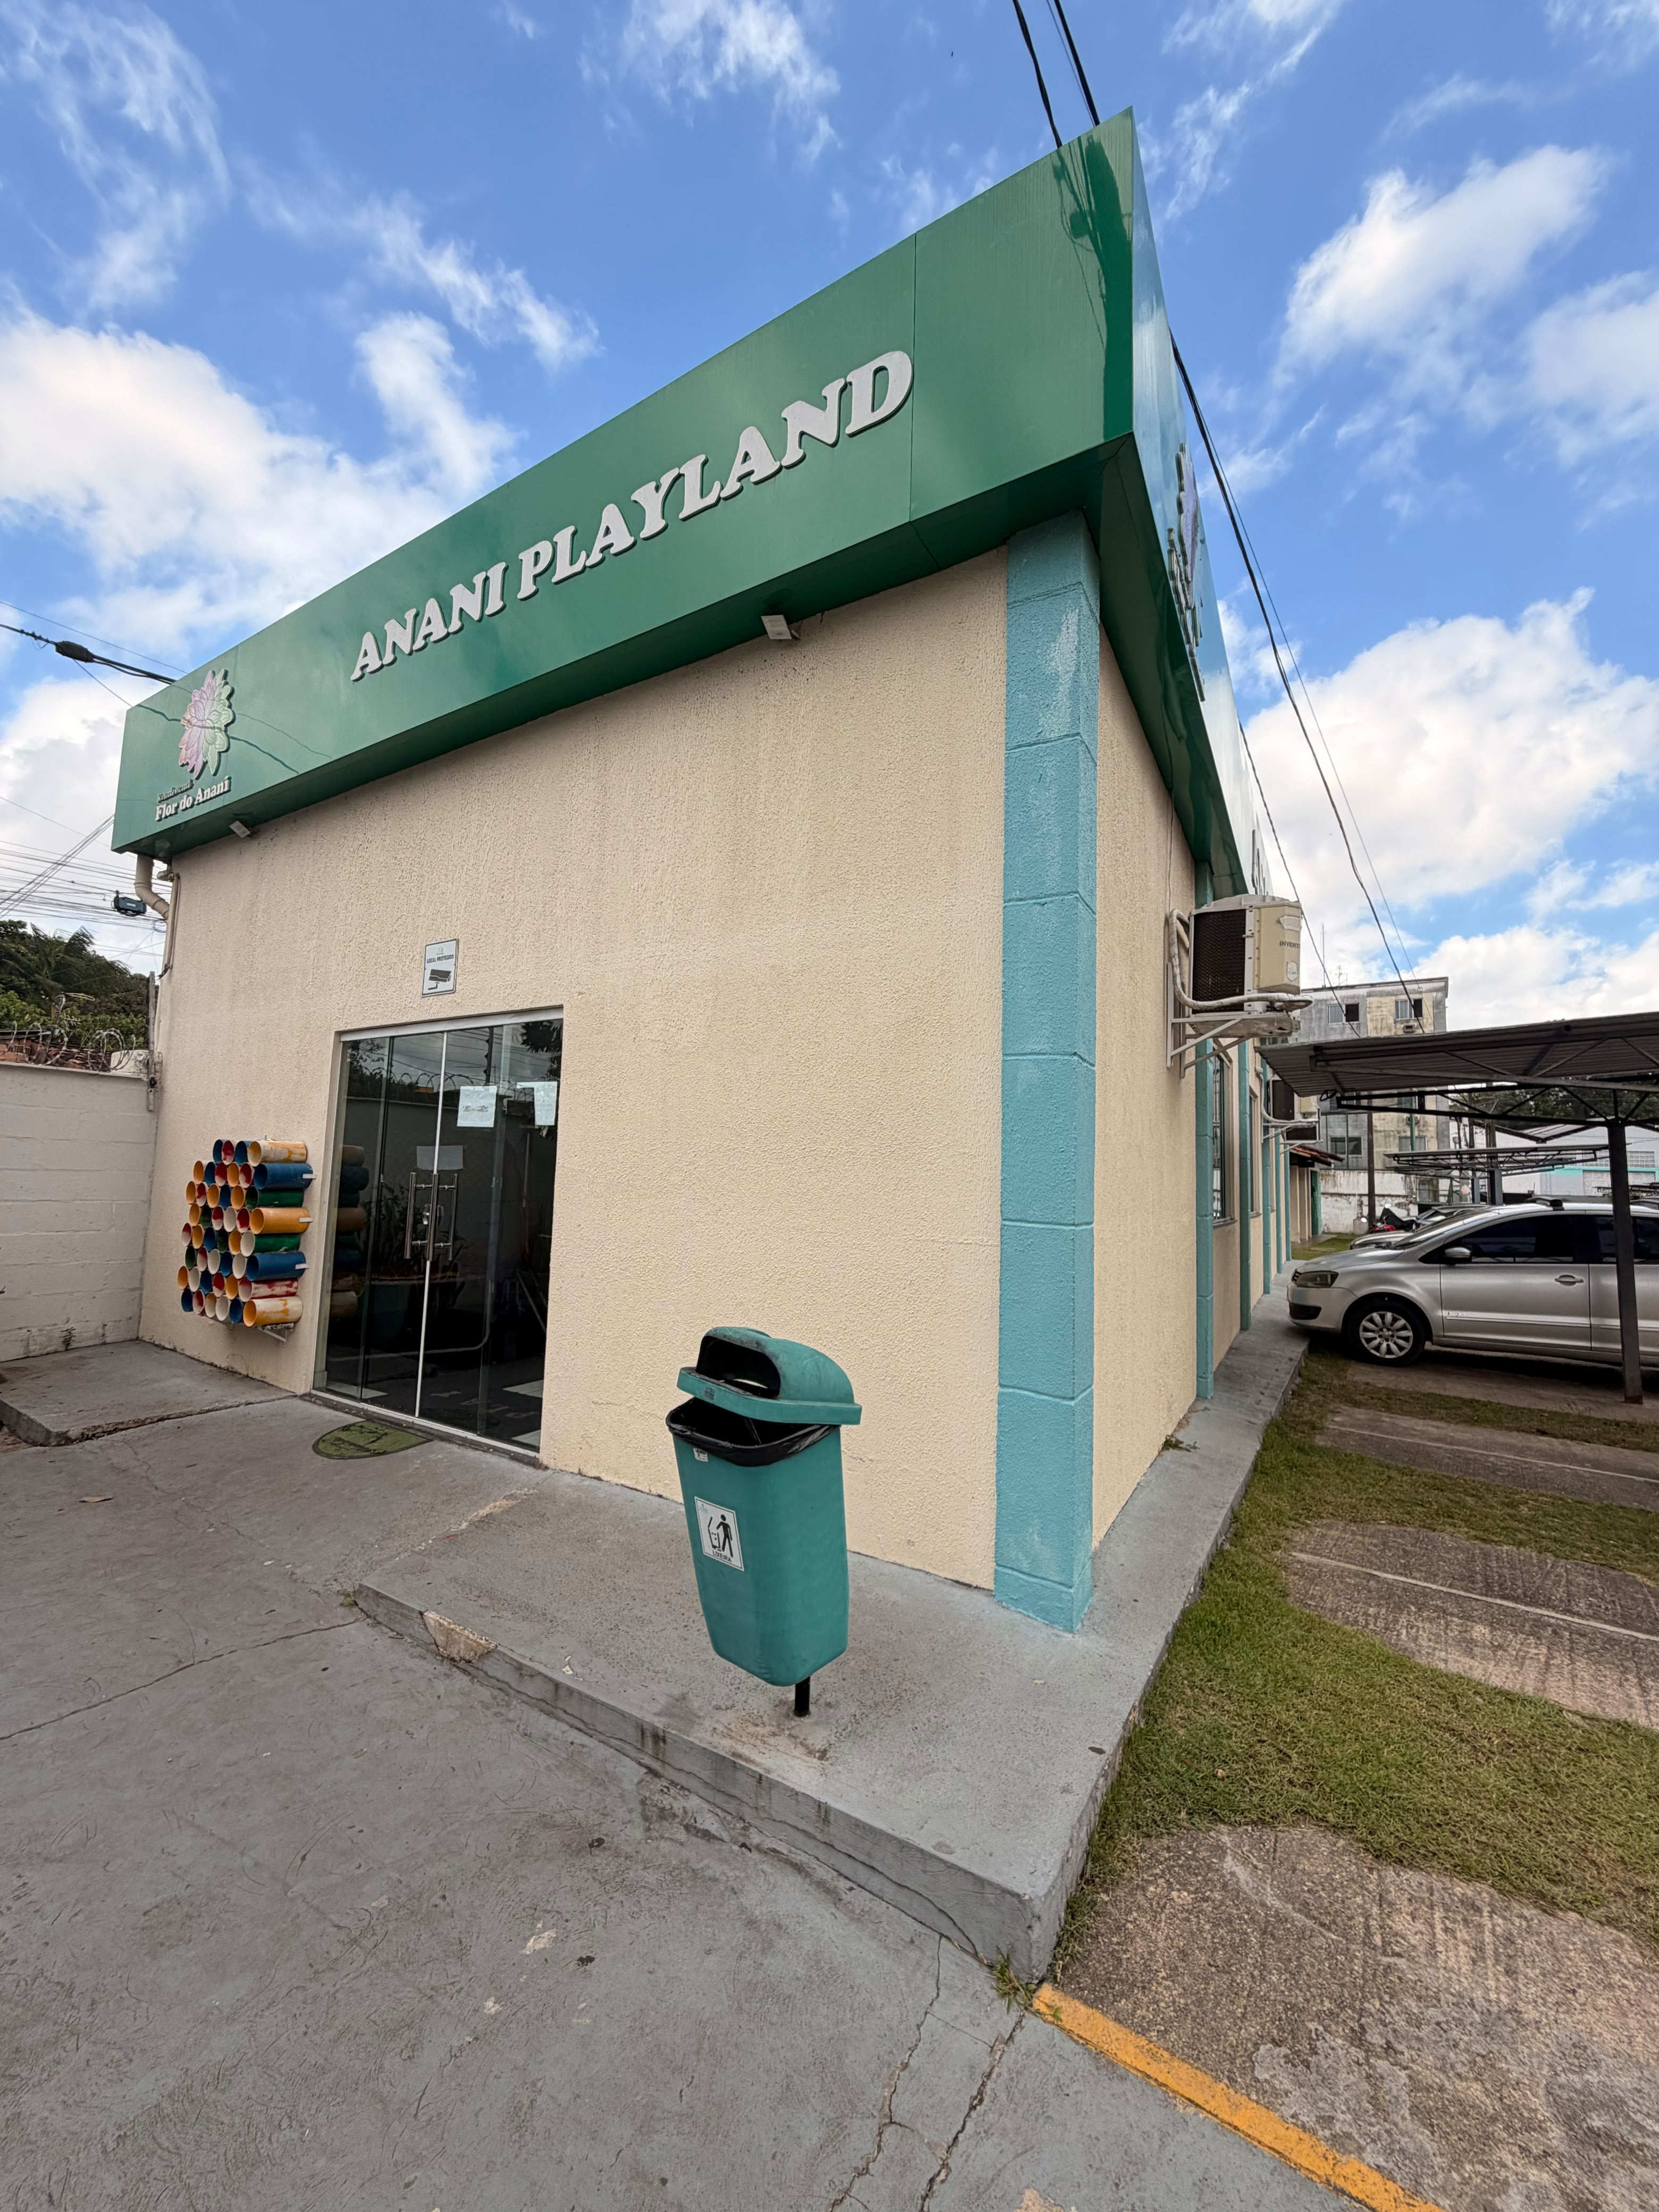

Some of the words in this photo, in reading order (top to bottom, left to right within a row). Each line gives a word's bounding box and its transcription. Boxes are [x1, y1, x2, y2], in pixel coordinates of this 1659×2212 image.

[351, 562, 507, 681] ANANI
[517, 351, 913, 600] PLAYLAND
[155, 803, 178, 821] Flor
[179, 794, 193, 810] do
[713, 1549, 732, 1562] LIXEIRA
